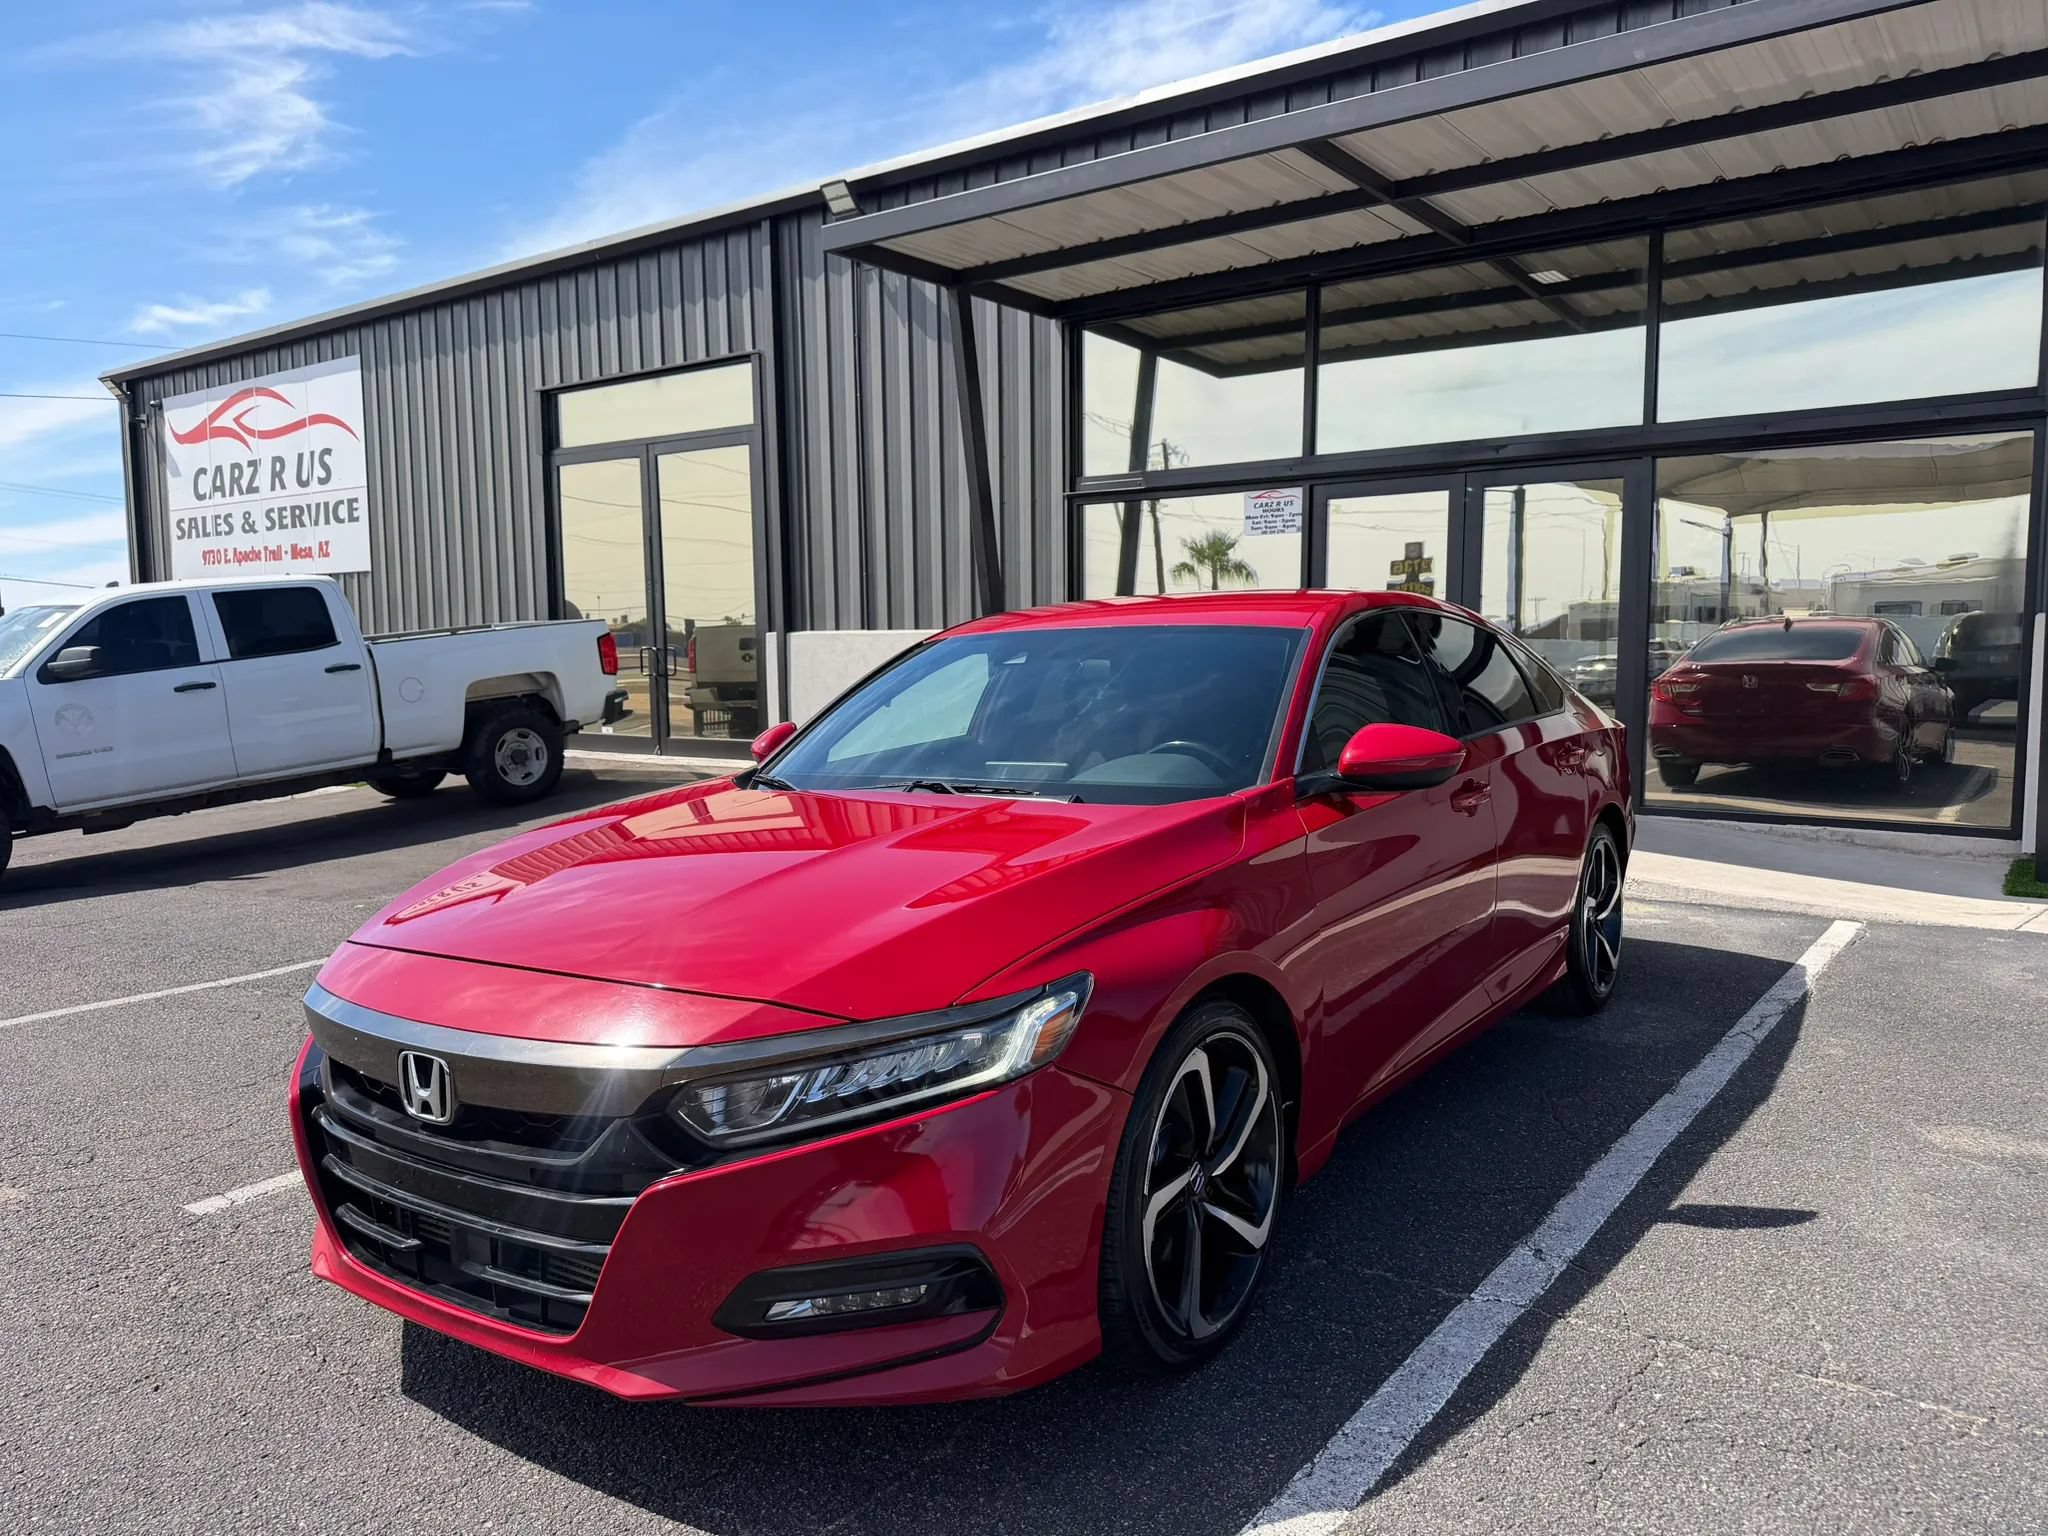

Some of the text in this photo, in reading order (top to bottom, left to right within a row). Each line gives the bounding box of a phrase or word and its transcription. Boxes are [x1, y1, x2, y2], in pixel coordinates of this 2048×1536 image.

[193, 448, 333, 501] CARZ R US
[176, 498, 360, 540] SALES & SERVICE
[202, 549, 222, 566] 9730
[224, 548, 231, 564] E.
[233, 546, 262, 566] Apache
[263, 544, 282, 562] Trail
[318, 540, 330, 558] AZ
